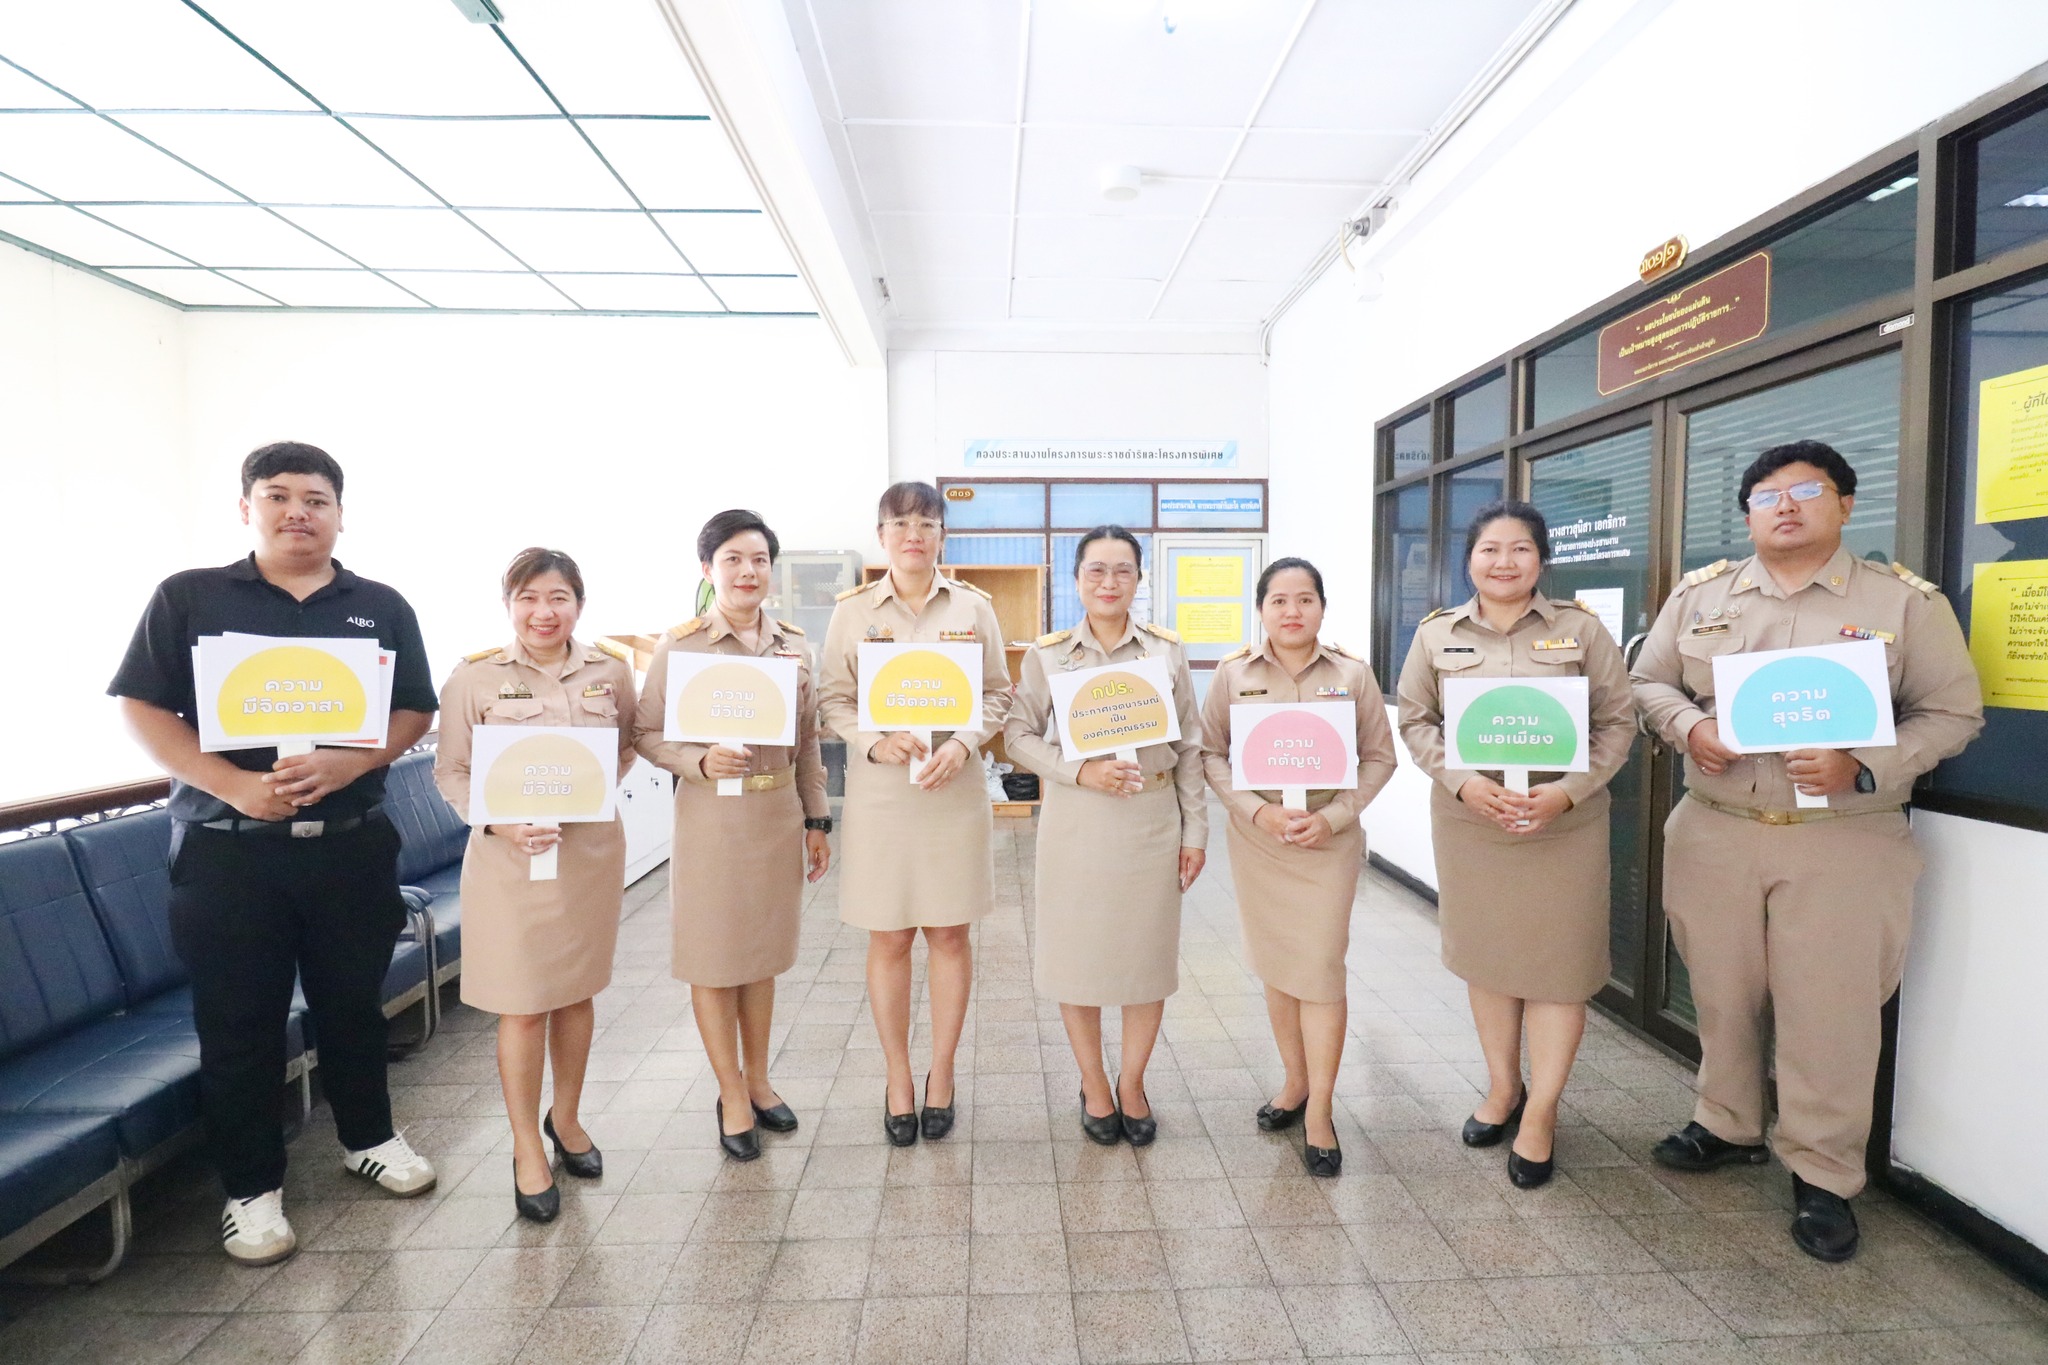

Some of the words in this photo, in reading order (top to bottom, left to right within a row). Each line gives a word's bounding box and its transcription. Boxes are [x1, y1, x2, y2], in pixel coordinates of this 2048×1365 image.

[976, 447, 1223, 460] กองประสานงานโครงการพระราชดำริและโครงการพิเศษ
[264, 679, 323, 692] ความ
[900, 678, 942, 690] ความ
[1091, 679, 1134, 700] กปร.
[711, 689, 755, 702] ความ
[885, 692, 957, 708] มีจิตอาสา
[1771, 687, 1828, 703] ความ
[242, 697, 344, 715] มีจิตอาสา
[709, 703, 755, 719] มีวินัย
[1071, 694, 1160, 719] ประกาศเจตนารมณ์
[1110, 712, 1127, 724] เป็น
[1491, 714, 1539, 726] ความ
[1772, 706, 1831, 729] สุจริต
[1082, 719, 1158, 741] องค์กรคุณธรรม
[1478, 730, 1554, 746] พอเพียง
[1273, 738, 1314, 749] ความ
[1267, 752, 1321, 770] กตัญญู
[523, 764, 573, 777] ความ
[522, 781, 573, 796] มีวินัย
